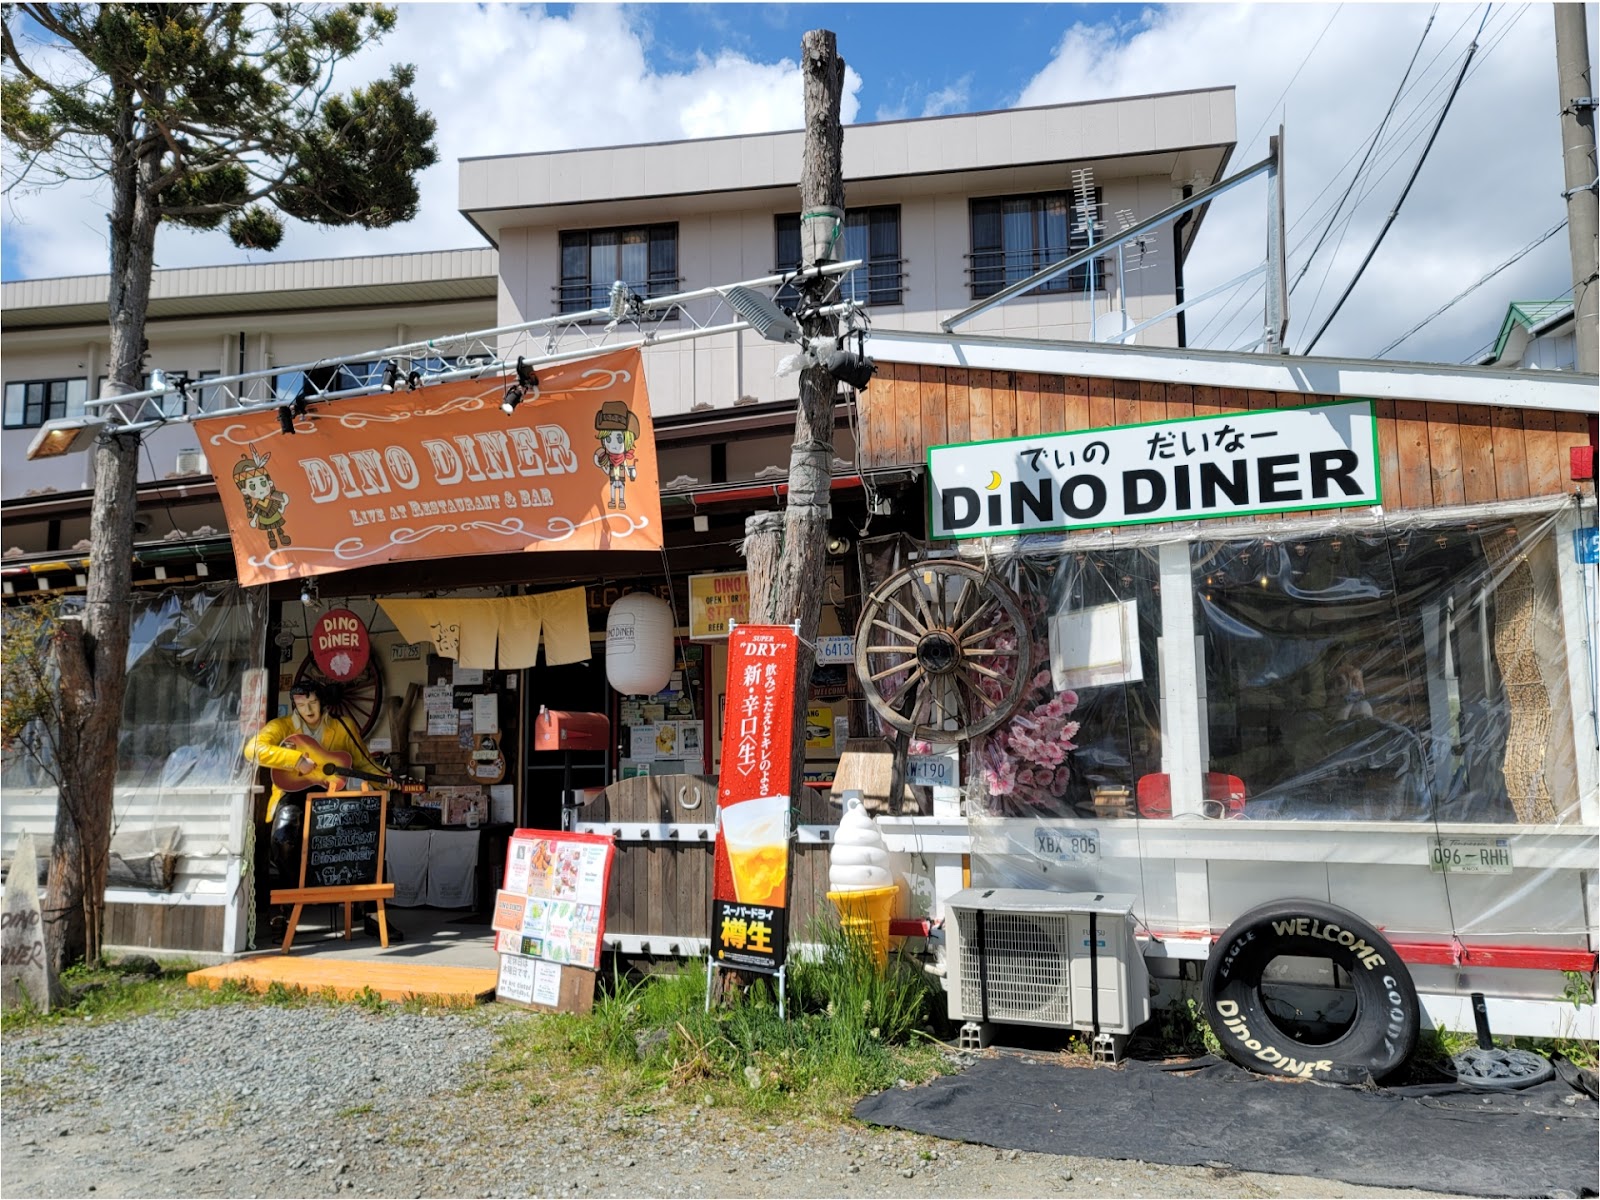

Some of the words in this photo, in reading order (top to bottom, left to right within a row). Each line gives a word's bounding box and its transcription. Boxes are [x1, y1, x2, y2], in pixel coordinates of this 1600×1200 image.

[1147, 424, 1278, 461] だいなー
[299, 442, 420, 503] DINO
[423, 423, 579, 485] DINER
[1123, 449, 1365, 515] DINER
[503, 490, 517, 508] &
[714, 576, 741, 593] DINO
[706, 595, 722, 604] OPEN
[323, 616, 358, 633] DINO
[708, 622, 724, 632] BEER
[814, 687, 846, 696] WELCOME
[759, 663, 778, 797] 飲みごたえとキレのよさ
[315, 811, 370, 830] IZAKAYA
[1038, 836, 1063, 853] XBX
[1071, 837, 1096, 854] 805
[1449, 839, 1488, 847] Tennessee
[722, 905, 774, 921] スーパードライ
[720, 916, 773, 953] 樽生
[1272, 918, 1386, 971] WELCOME
[1220, 930, 1257, 978] EAGLE
